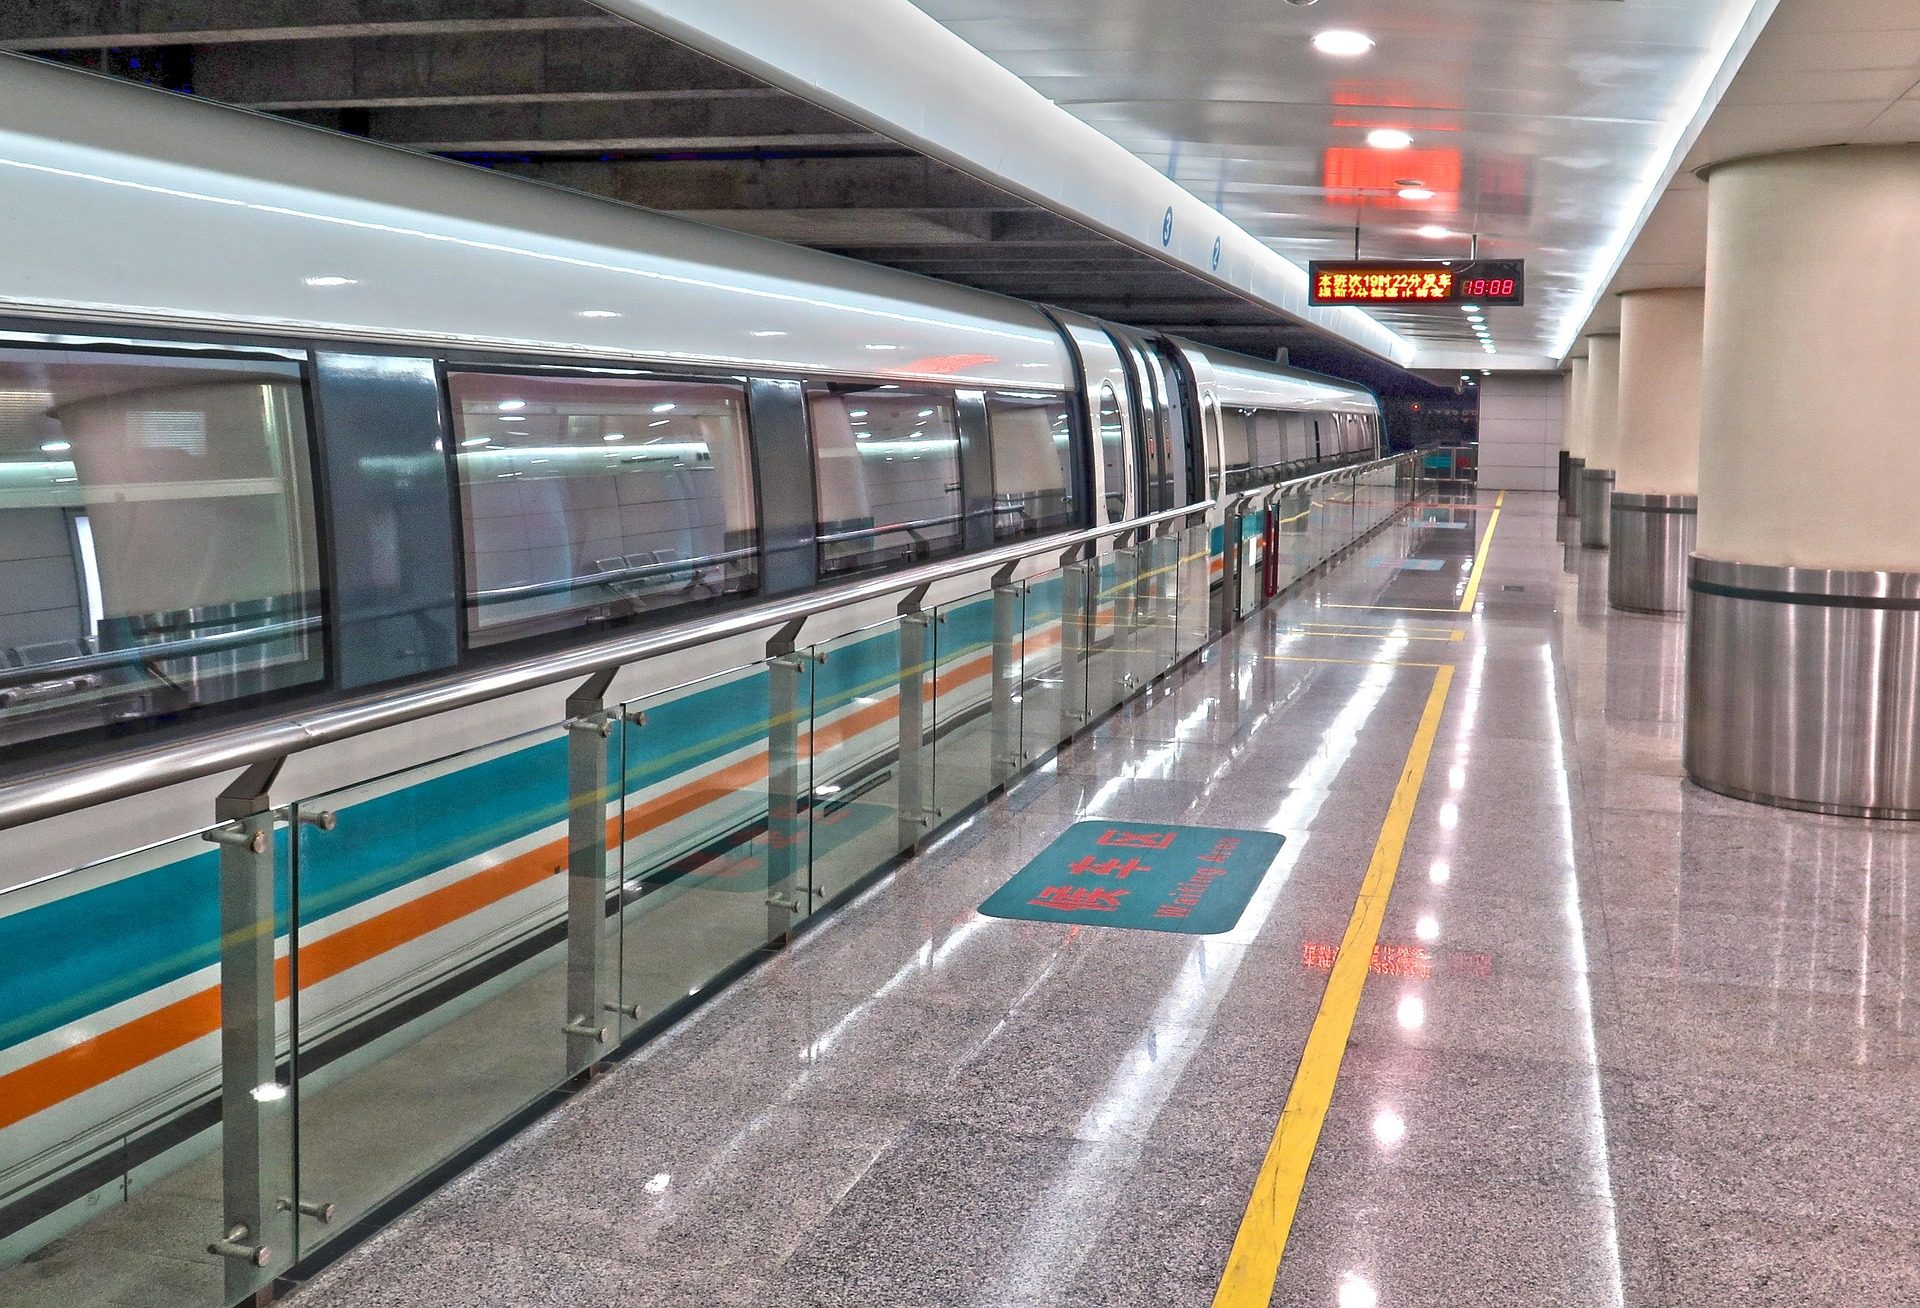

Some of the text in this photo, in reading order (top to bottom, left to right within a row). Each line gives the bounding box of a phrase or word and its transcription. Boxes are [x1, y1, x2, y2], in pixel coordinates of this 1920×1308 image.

[1466, 279, 1515, 296] 19:08
[1027, 828, 1178, 912] 候车区
[1152, 836, 1244, 919] Waiting Area
